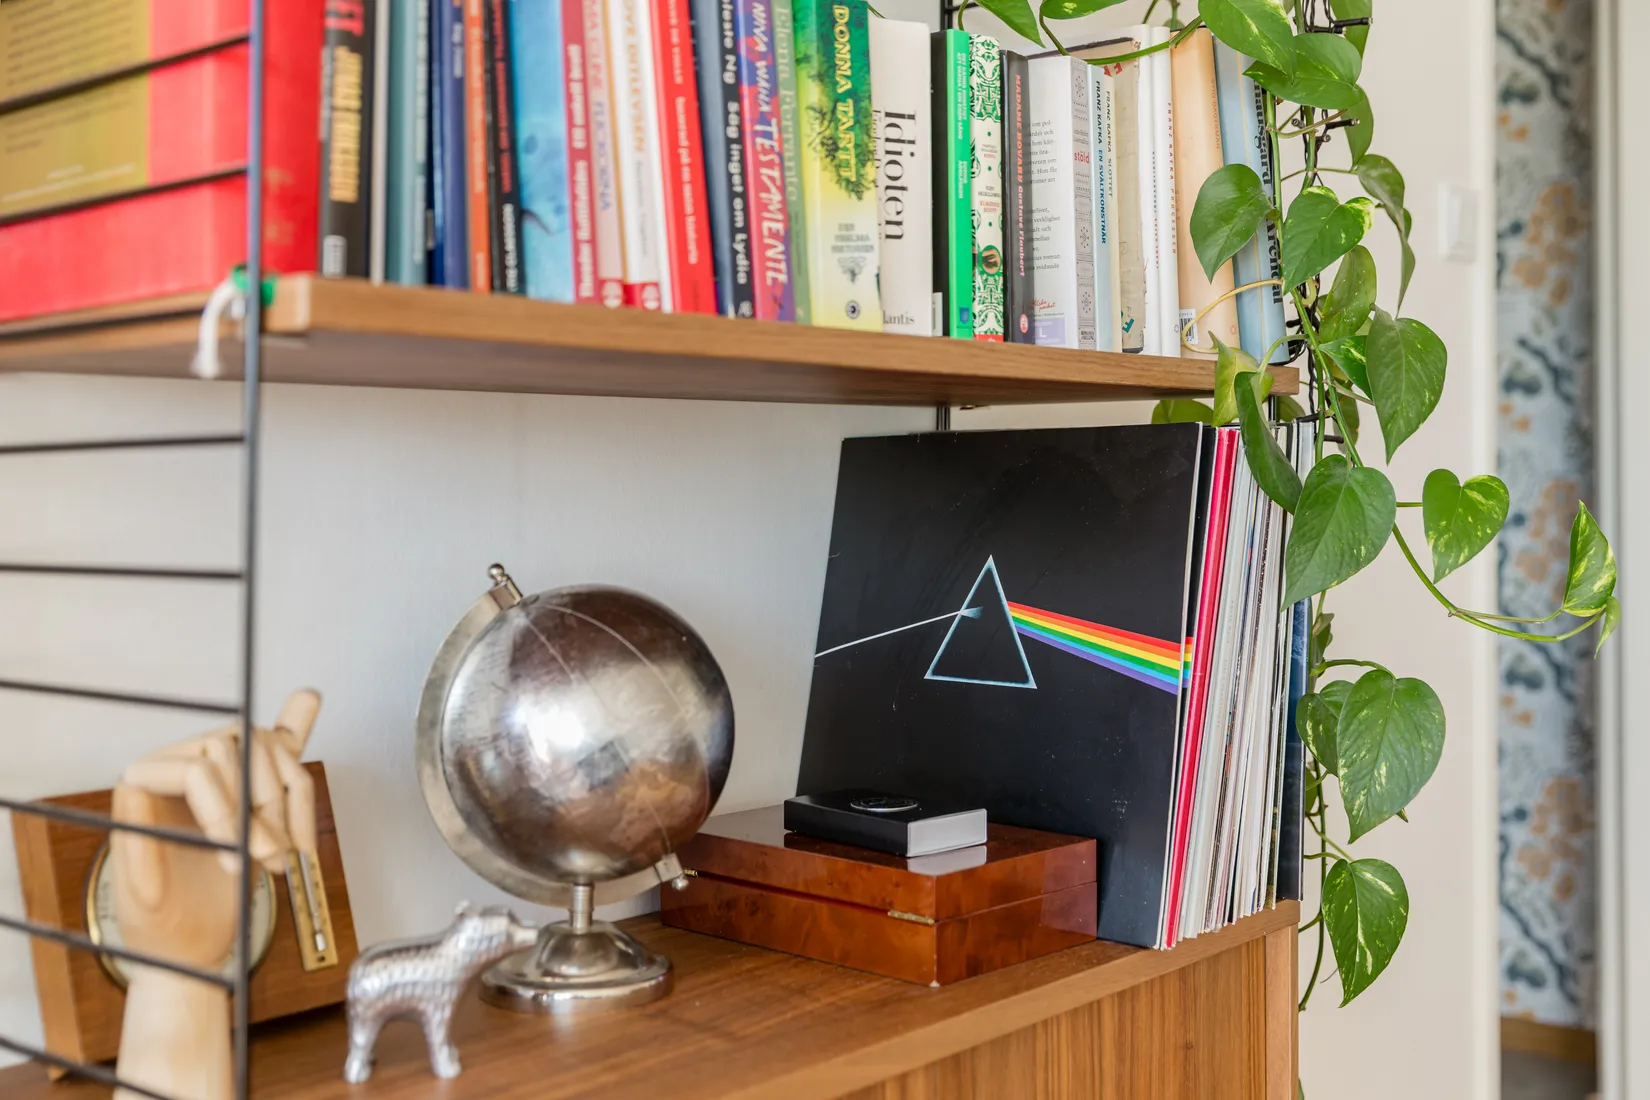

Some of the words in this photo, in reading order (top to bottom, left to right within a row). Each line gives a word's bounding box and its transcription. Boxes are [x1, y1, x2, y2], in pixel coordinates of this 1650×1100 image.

[721, 0, 735, 49] leste
[776, 7, 791, 81] Elena
[832, 4, 852, 94] DONNA
[722, 54, 738, 84] Ng
[725, 101, 741, 139] Säg
[1014, 73, 1023, 130] MADAME
[1212, 101, 1221, 150] DAGERMAN
[780, 89, 799, 201] Ferrante
[836, 98, 857, 182] TARTT
[1016, 131, 1025, 183] BOVARY
[1073, 150, 1090, 164] stöld
[1098, 149, 1103, 162] EN
[727, 143, 744, 194] inget
[883, 108, 917, 243] Idioten
[732, 197, 745, 229] om
[753, 117, 788, 287] TESTAMENTE
[1017, 186, 1025, 229] Gustave
[1034, 215, 1061, 223] verklighet
[1098, 164, 1106, 244] SVÄLTKONSTNÄR
[732, 233, 751, 285] Lydia
[1018, 230, 1026, 277] Flaubert
[882, 310, 915, 325] lantis
